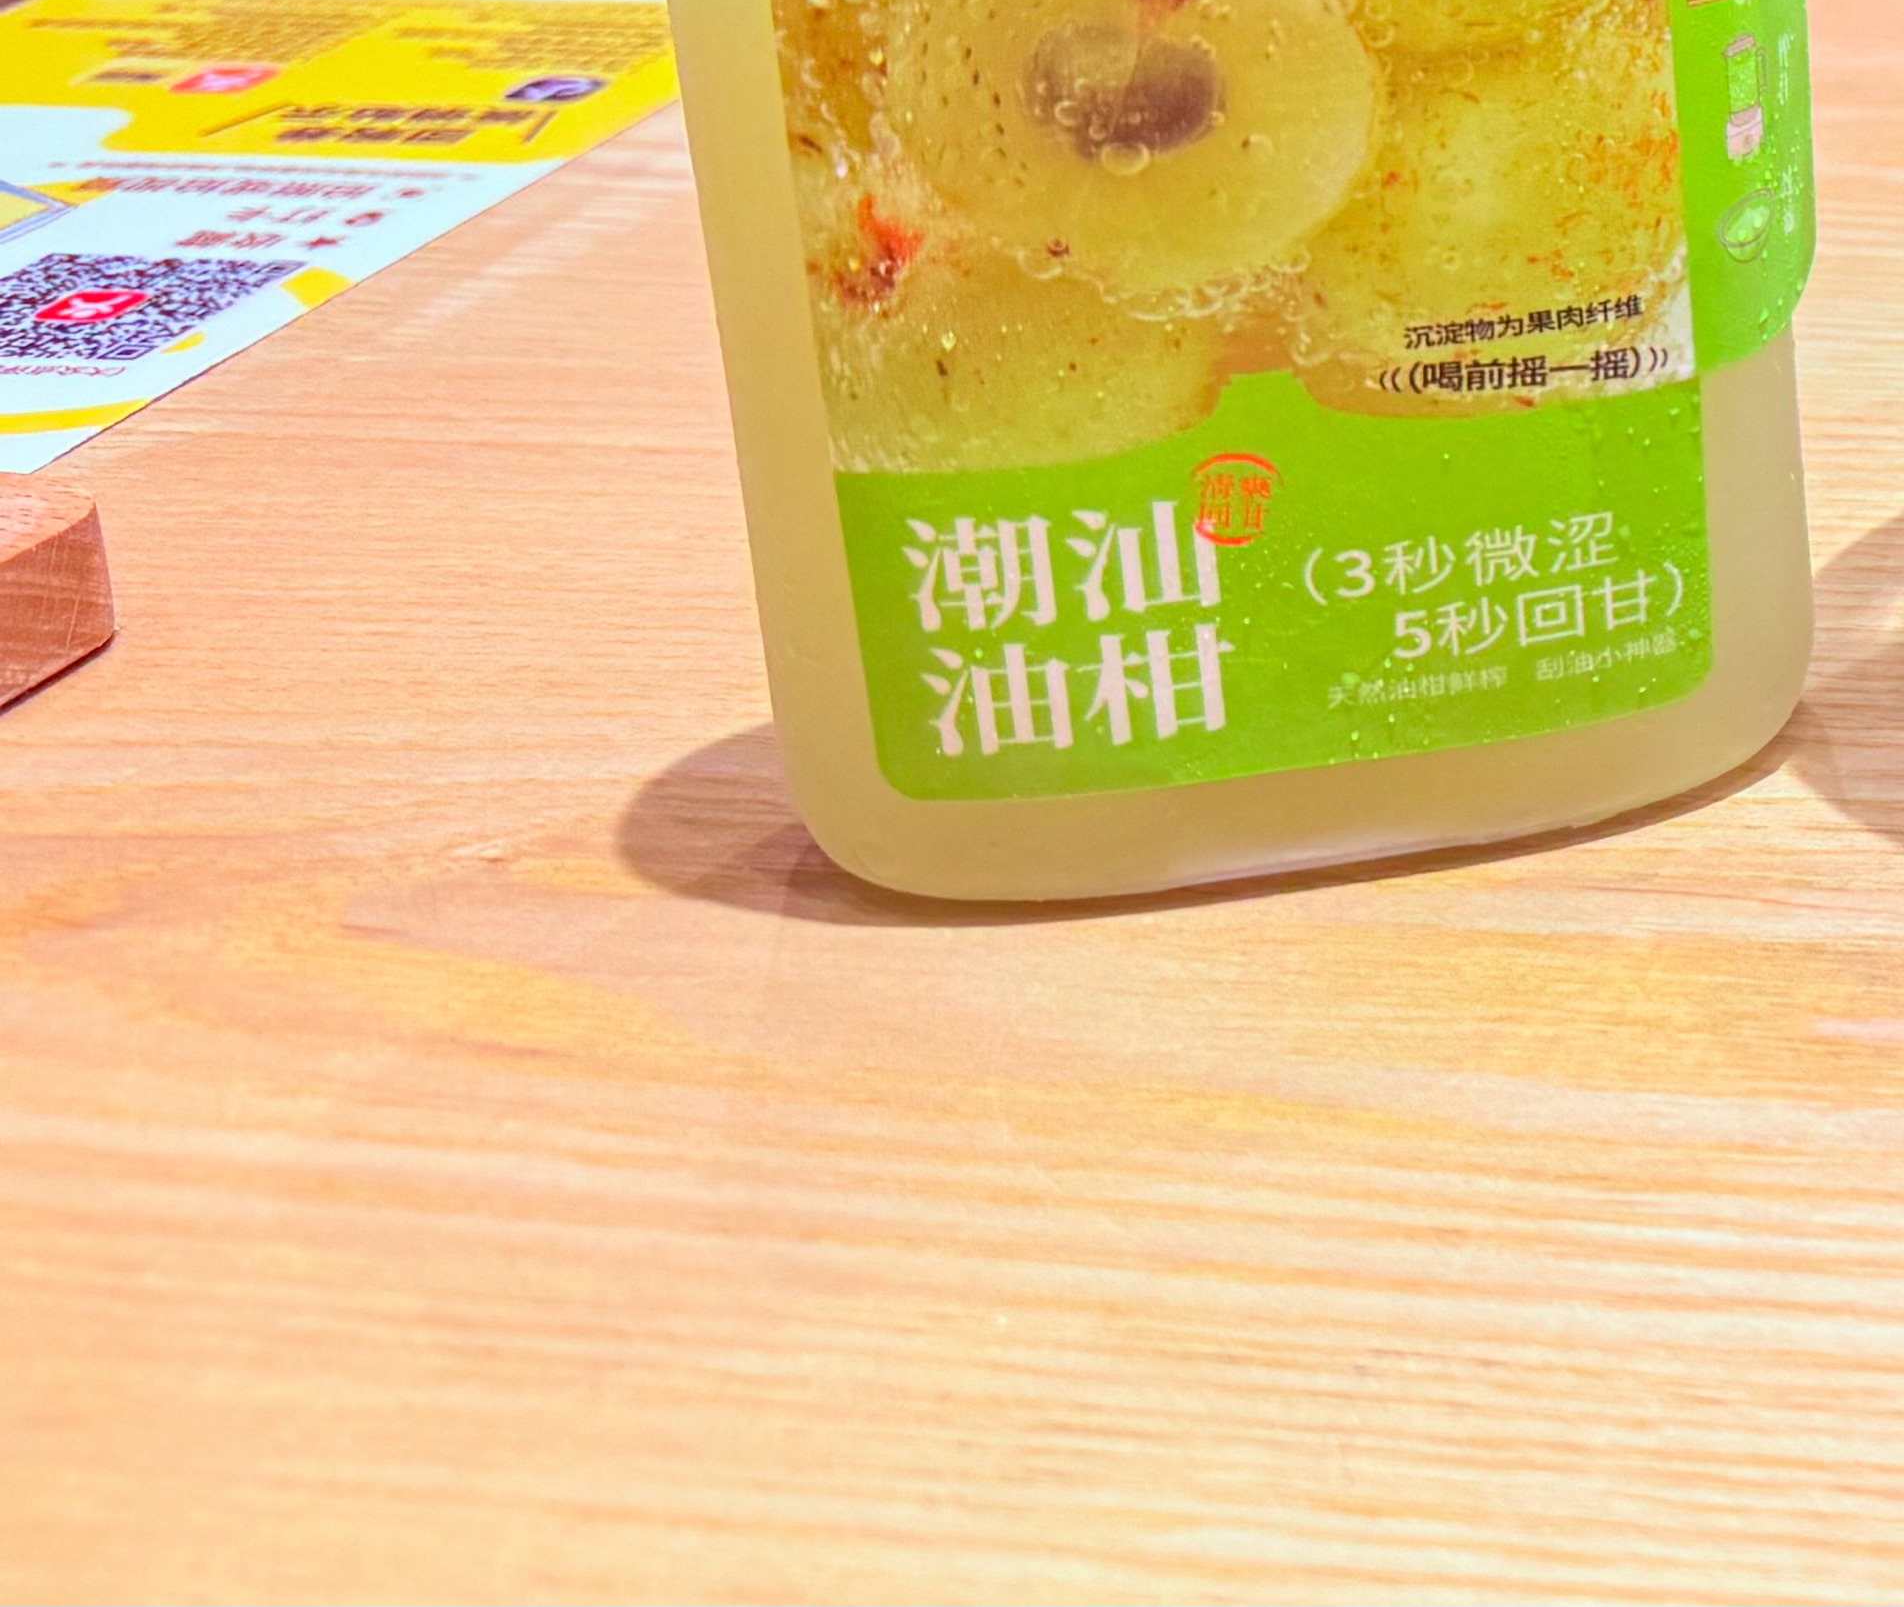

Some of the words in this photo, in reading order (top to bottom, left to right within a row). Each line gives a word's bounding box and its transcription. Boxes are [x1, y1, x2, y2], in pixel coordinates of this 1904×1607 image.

[1403, 294, 1644, 351] 沉淀物为果肉纤维
[901, 500, 1222, 633] 潮汕
[920, 623, 1236, 757] 油柑
[1327, 664, 1508, 710] 天然油柑鲜榨
[1535, 631, 1678, 682] 刮油小神器
